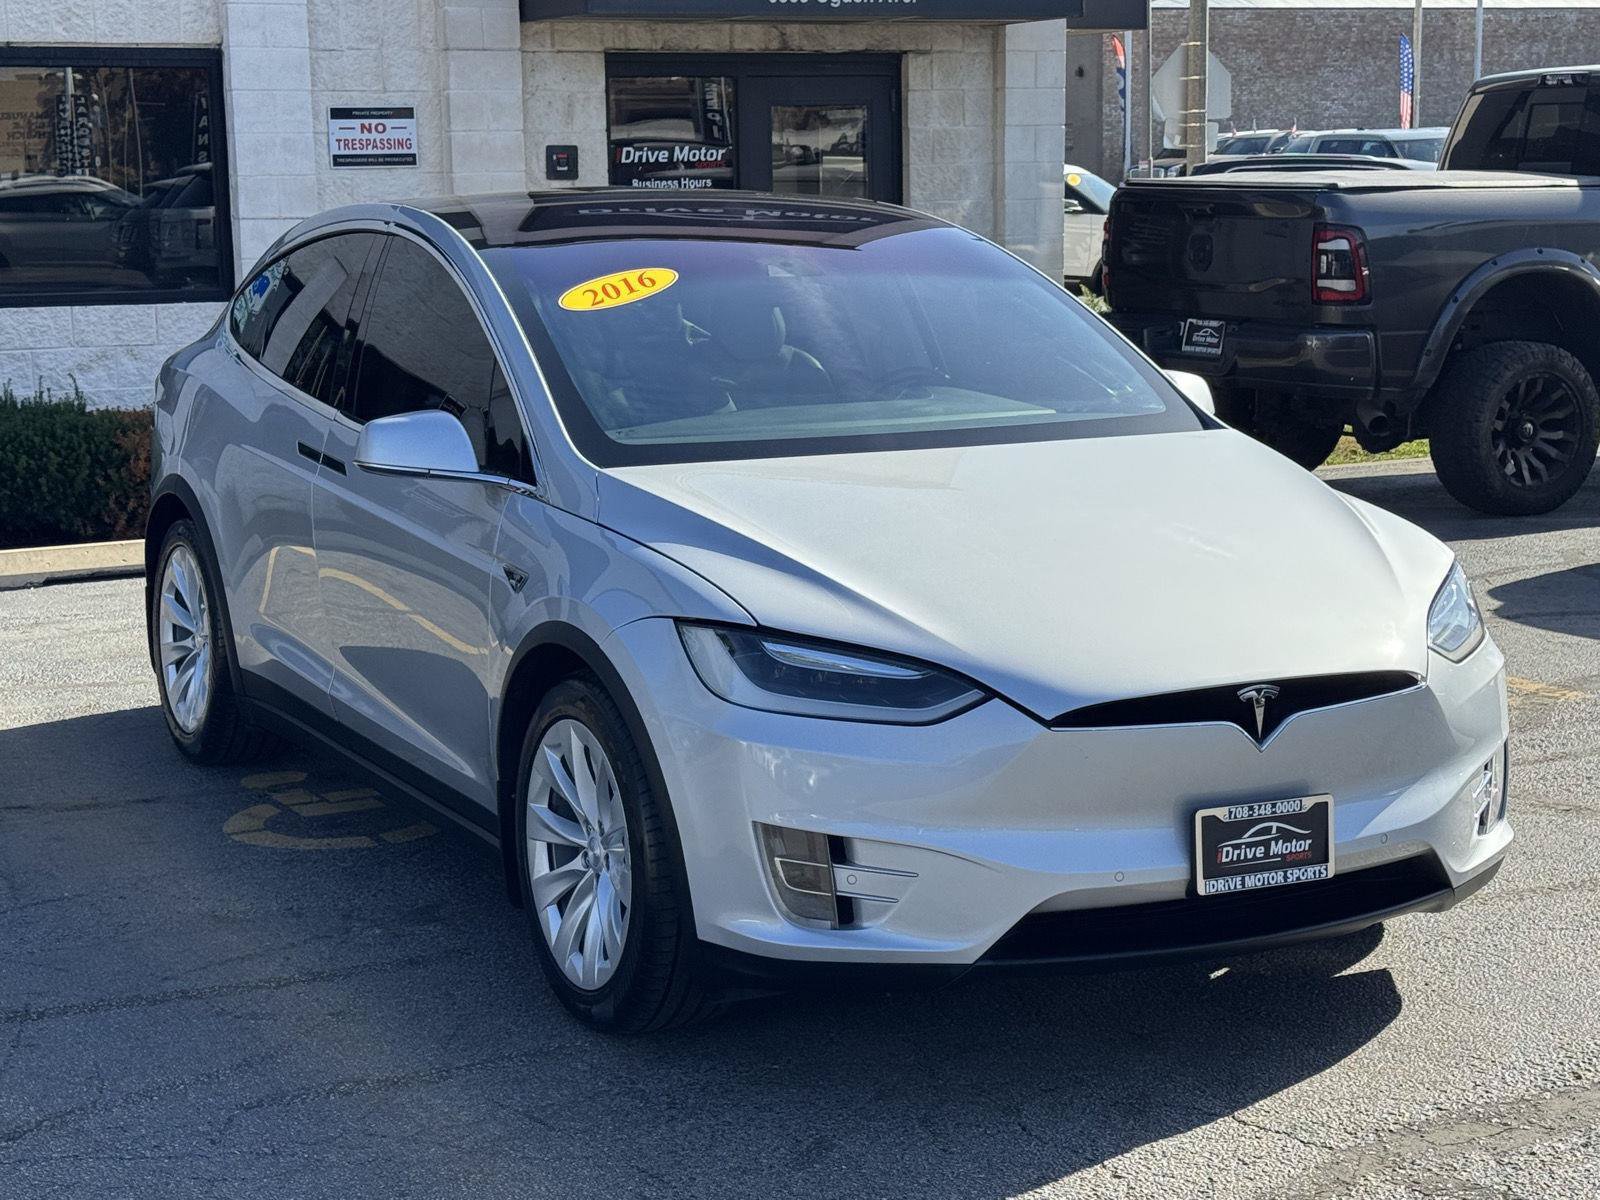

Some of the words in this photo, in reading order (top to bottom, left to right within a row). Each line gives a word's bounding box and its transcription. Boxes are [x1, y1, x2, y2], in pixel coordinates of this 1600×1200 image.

[360, 122, 387, 134] NO
[336, 138, 413, 151] TRESPASSING
[673, 145, 727, 162] Motor
[632, 179, 679, 189] Business
[681, 178, 712, 189] Hours
[582, 271, 656, 307] 2016
[1230, 801, 1301, 819] 708-348-0000
[1217, 845, 1264, 864] iDrive
[1270, 839, 1312, 856] Motor
[1245, 870, 1285, 887] MOTOR
[1287, 865, 1327, 882] SPORTS
